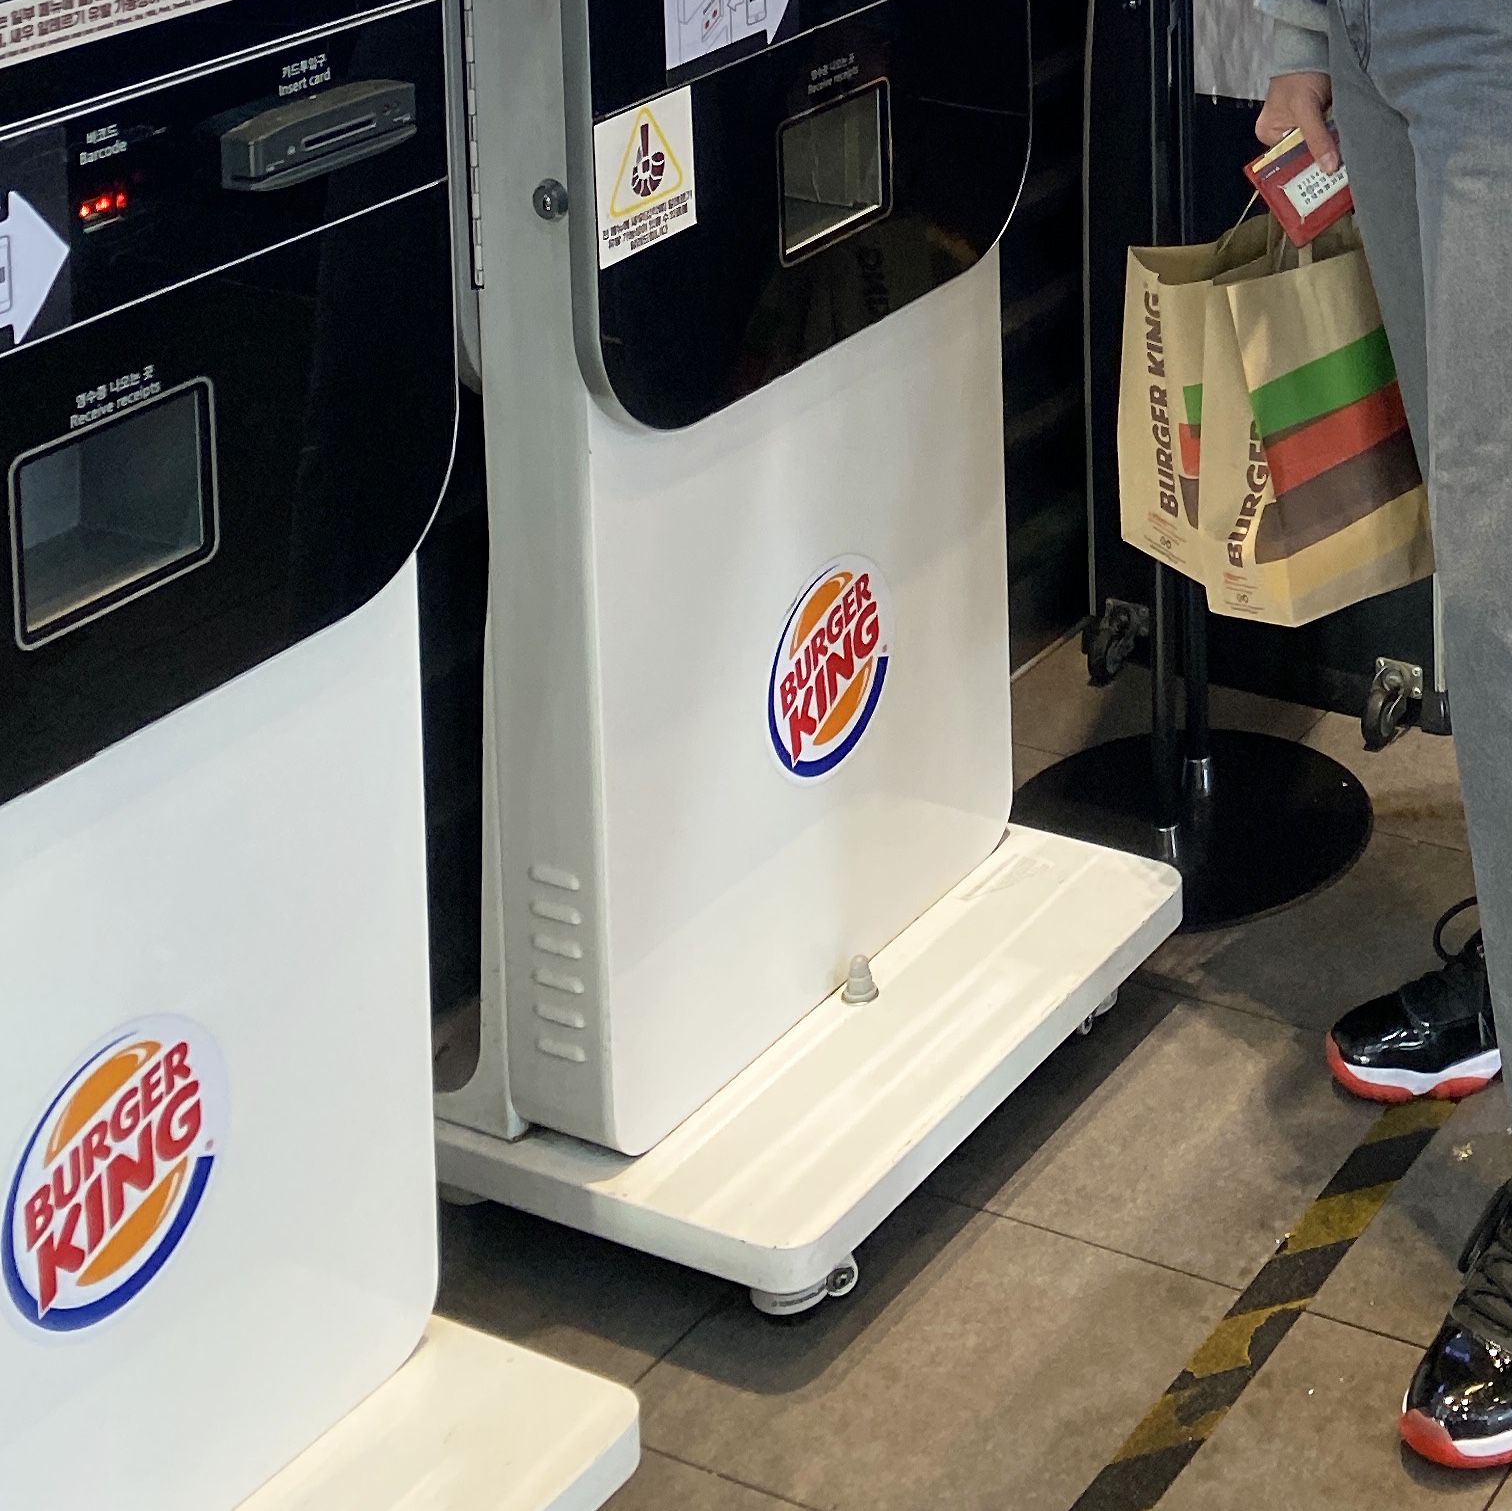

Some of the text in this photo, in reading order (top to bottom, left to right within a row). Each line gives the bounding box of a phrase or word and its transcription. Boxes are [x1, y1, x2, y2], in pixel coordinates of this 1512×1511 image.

[11, 3, 35, 26] 일부
[37, 8, 85, 37] 알레르기
[279, 67, 331, 97] Insert card
[282, 53, 327, 78] 카드투입구
[79, 140, 128, 166] Barcode
[1144, 290, 1166, 378] KING
[70, 379, 162, 430] Receive receipts
[110, 371, 141, 397] 나오는
[1150, 384, 1179, 518] BURGER
[779, 572, 873, 720] BURGER
[789, 600, 880, 764] KING
[25, 1040, 192, 1254] BURGER
[36, 1078, 202, 1312] KING
